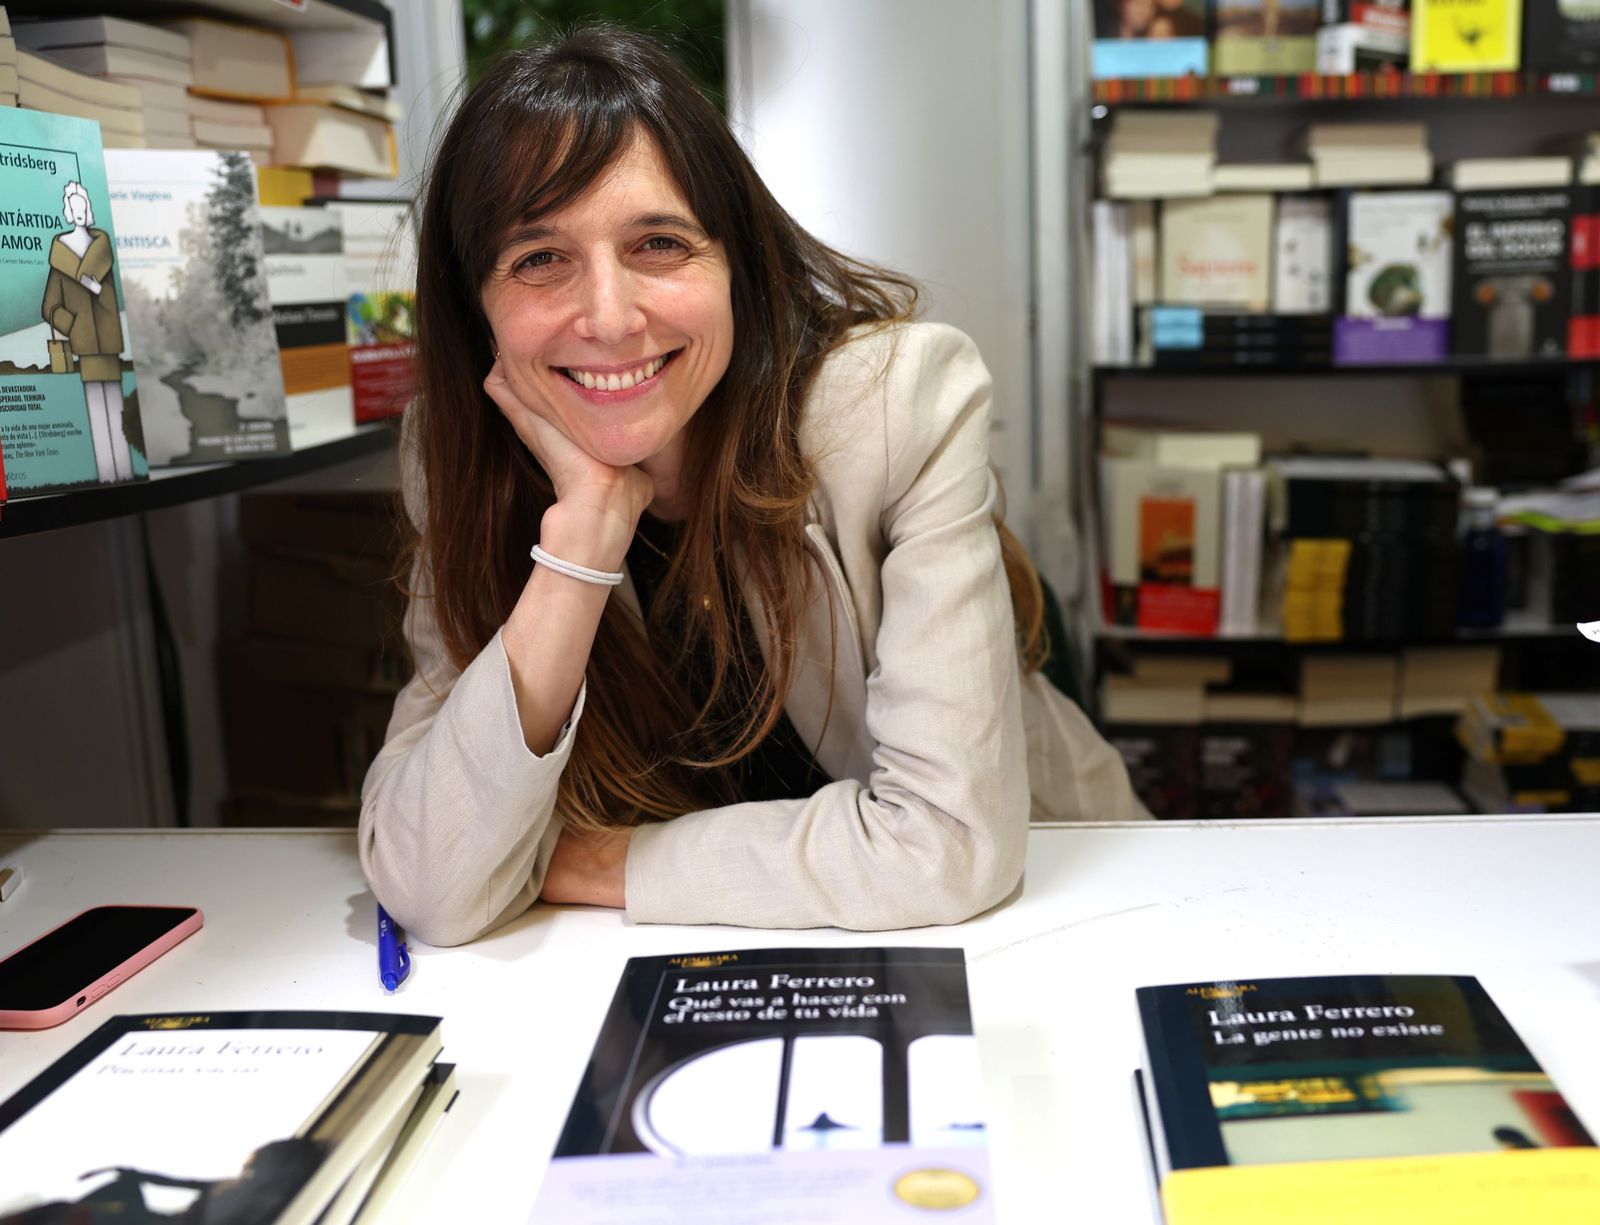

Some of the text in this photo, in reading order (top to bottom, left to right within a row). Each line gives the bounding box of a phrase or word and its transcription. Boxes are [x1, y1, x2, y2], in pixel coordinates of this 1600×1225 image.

[0, 152, 57, 175] tridsberg
[0, 208, 63, 230] NTÁRTIDA
[1, 234, 43, 251] AMOR
[2, 385, 36, 393] DEVASTADORA
[17, 432, 28, 440] vista
[22, 423, 28, 431] de
[15, 451, 23, 459] The
[674, 973, 875, 994] Laura Ferrero
[668, 992, 907, 1011] Qué vas a hacer con
[663, 1003, 879, 1024] el resto de tu vida
[1208, 1004, 1415, 1026] Laura Ferrero
[1213, 1021, 1445, 1046] La gente no existe
[120, 1041, 324, 1056] Laura Ferrero
